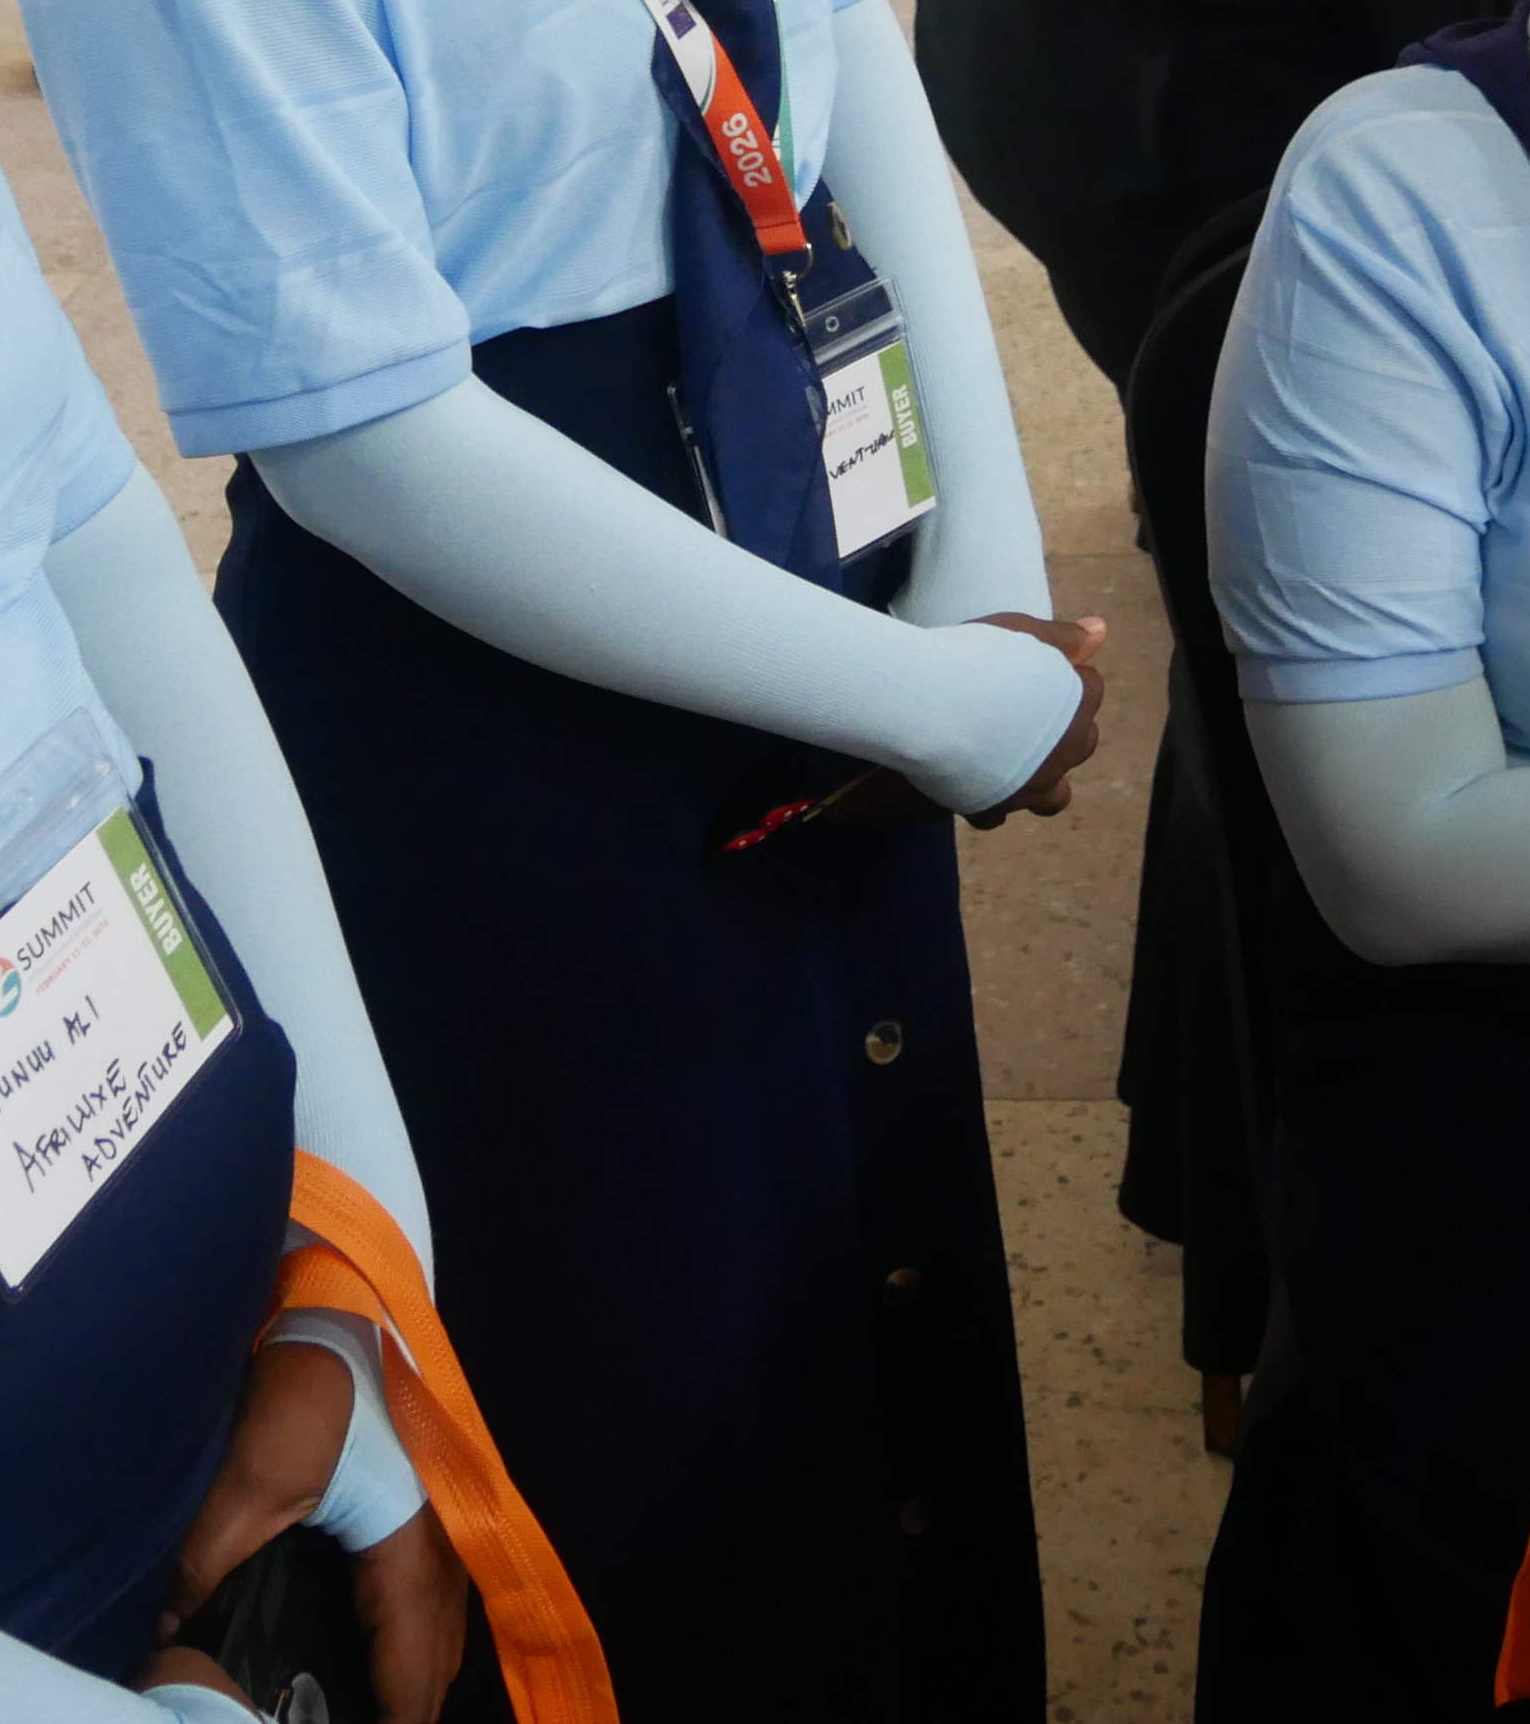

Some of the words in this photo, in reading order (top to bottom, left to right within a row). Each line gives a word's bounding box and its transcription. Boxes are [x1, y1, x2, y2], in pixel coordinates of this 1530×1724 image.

[720, 112, 773, 188] 2026
[826, 385, 865, 417] MMIT
[891, 383, 919, 449] BUYER
[16, 881, 98, 972] SUMMIT
[129, 863, 183, 957] BUYER
[80, 1021, 188, 1182] ADVENTURE
